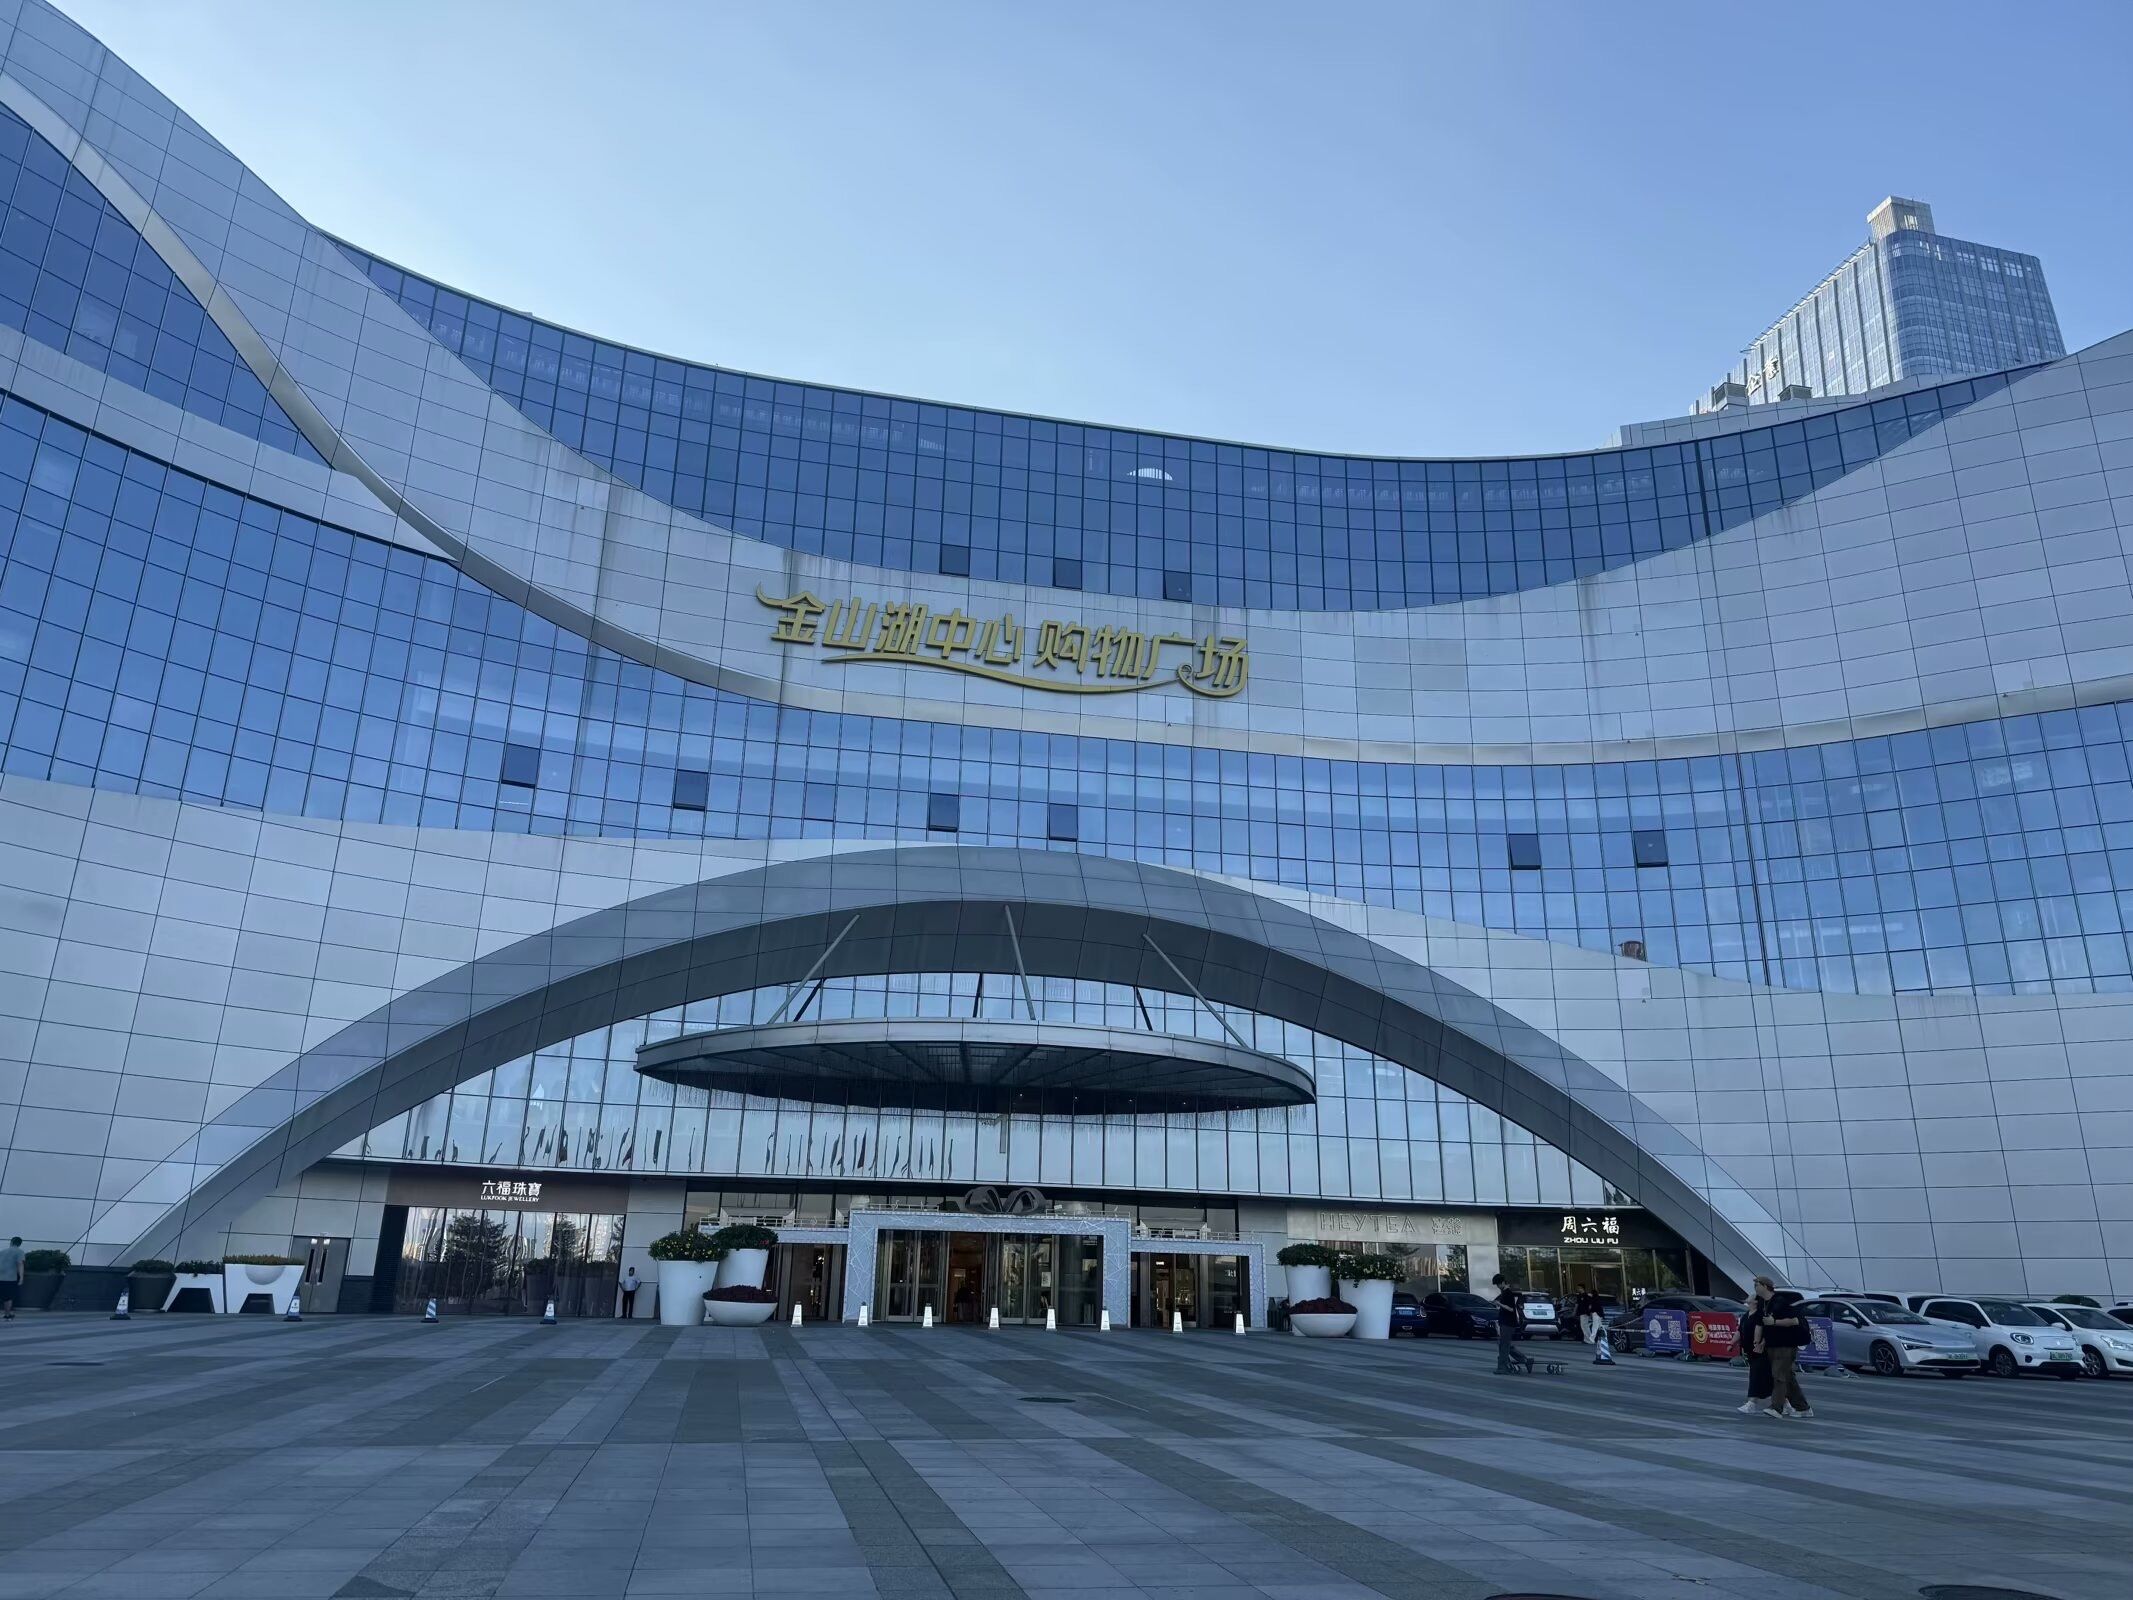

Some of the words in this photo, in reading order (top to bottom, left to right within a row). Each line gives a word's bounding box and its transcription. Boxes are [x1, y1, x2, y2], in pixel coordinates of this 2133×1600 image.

[482, 1180, 542, 1196] 六福珠寶
[1320, 1212, 1416, 1233] HEYTEA
[1561, 1216, 1620, 1235] 周六福
